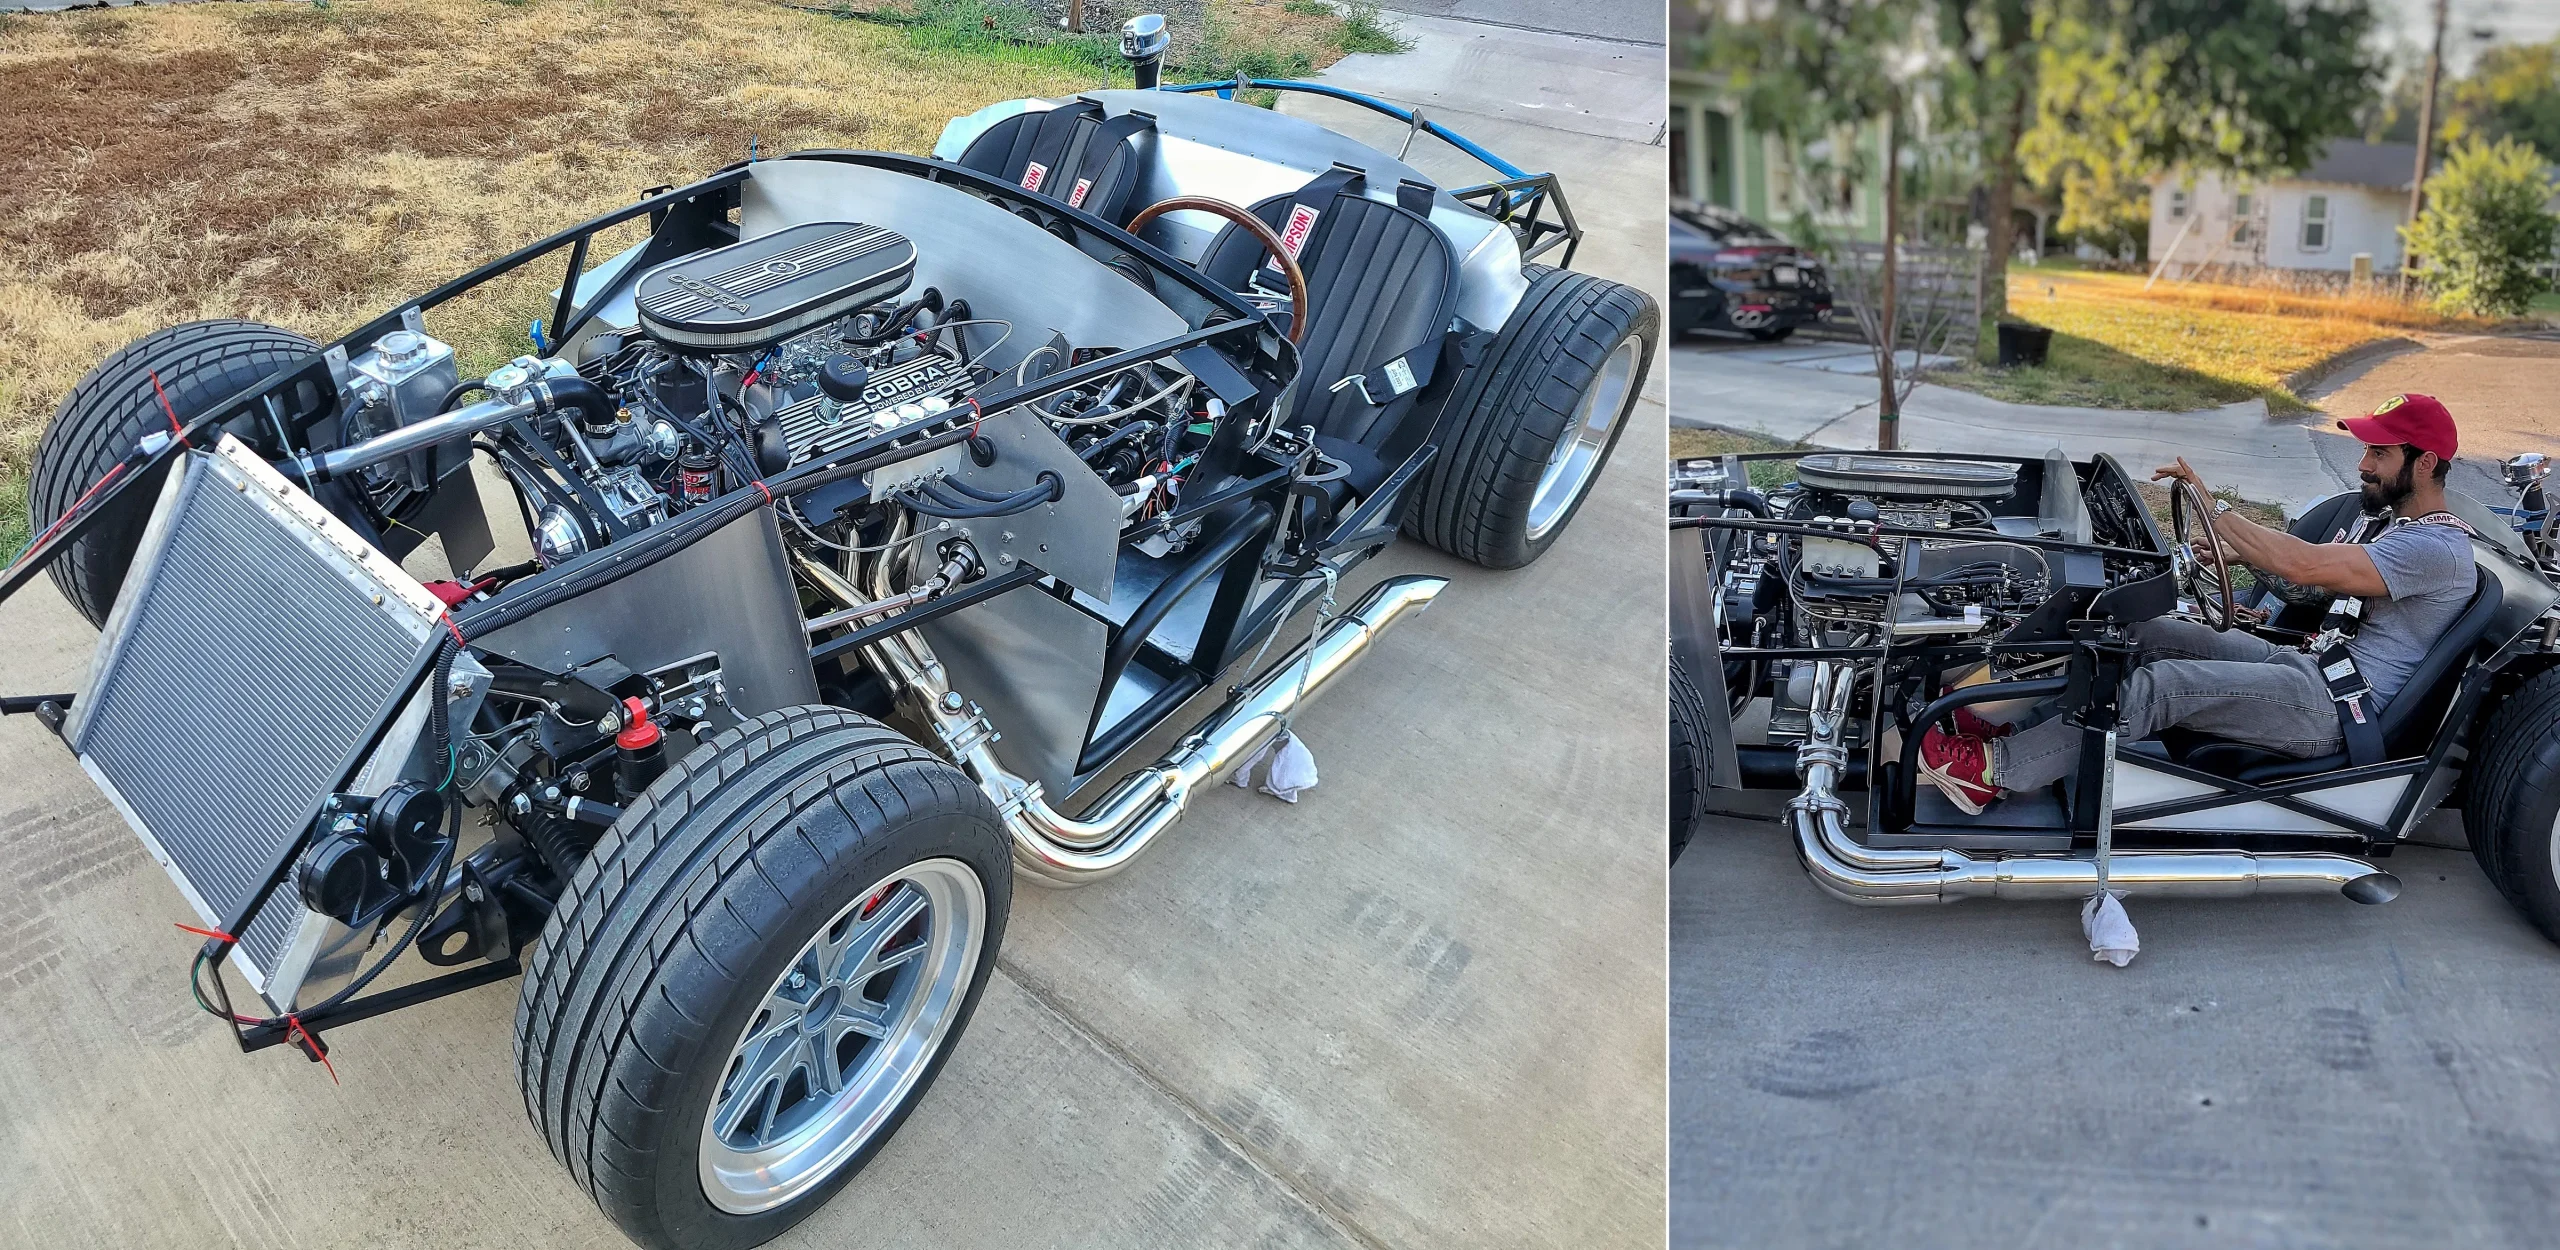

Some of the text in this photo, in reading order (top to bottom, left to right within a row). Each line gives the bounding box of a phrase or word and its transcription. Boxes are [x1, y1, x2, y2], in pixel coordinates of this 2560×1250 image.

[667, 273, 751, 316] COBRA
[862, 366, 946, 404] COBRA
[871, 377, 952, 412] POWERED BY FORD
